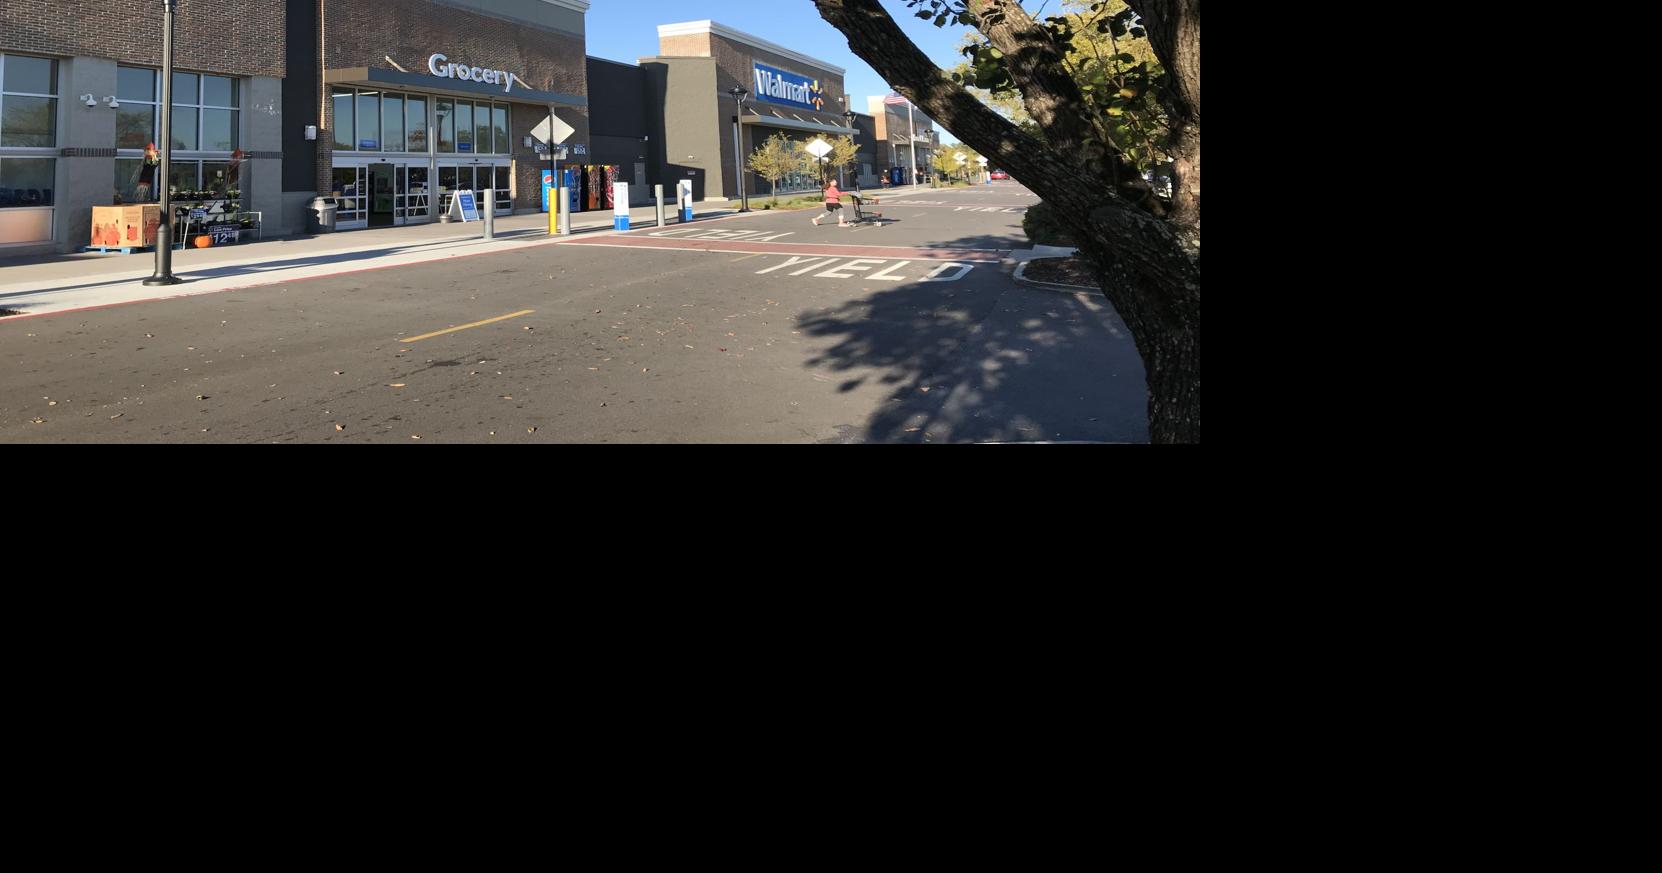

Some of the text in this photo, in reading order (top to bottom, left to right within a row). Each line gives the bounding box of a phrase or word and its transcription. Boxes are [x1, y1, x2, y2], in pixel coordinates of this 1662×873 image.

[428, 53, 514, 93] Grocery
[755, 68, 811, 105] Walmart
[754, 256, 975, 282] YIELD
